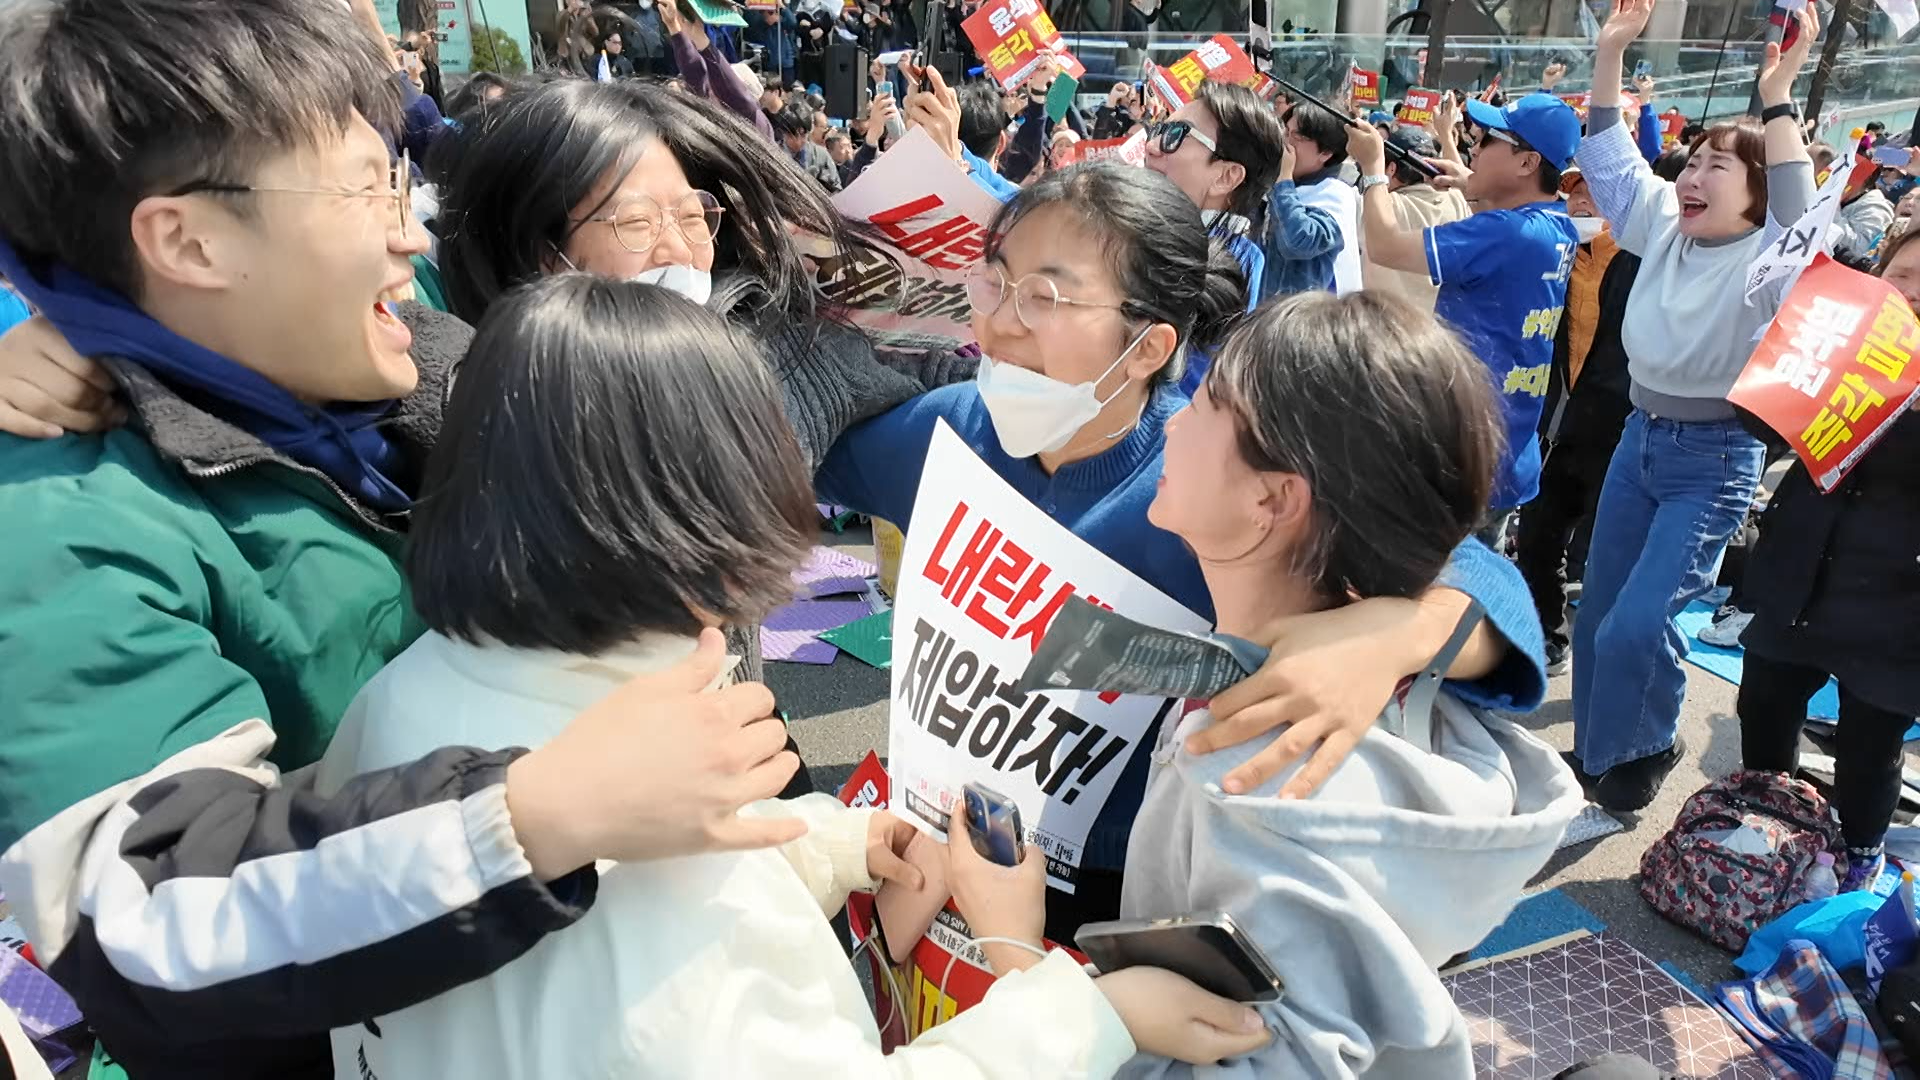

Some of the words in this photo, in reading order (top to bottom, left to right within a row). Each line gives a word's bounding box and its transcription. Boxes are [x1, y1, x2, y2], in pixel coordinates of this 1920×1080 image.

[988, 28, 1034, 70] 즉각
[1800, 370, 1888, 462] 즉각
[898, 615, 1130, 807] 제압하자!
